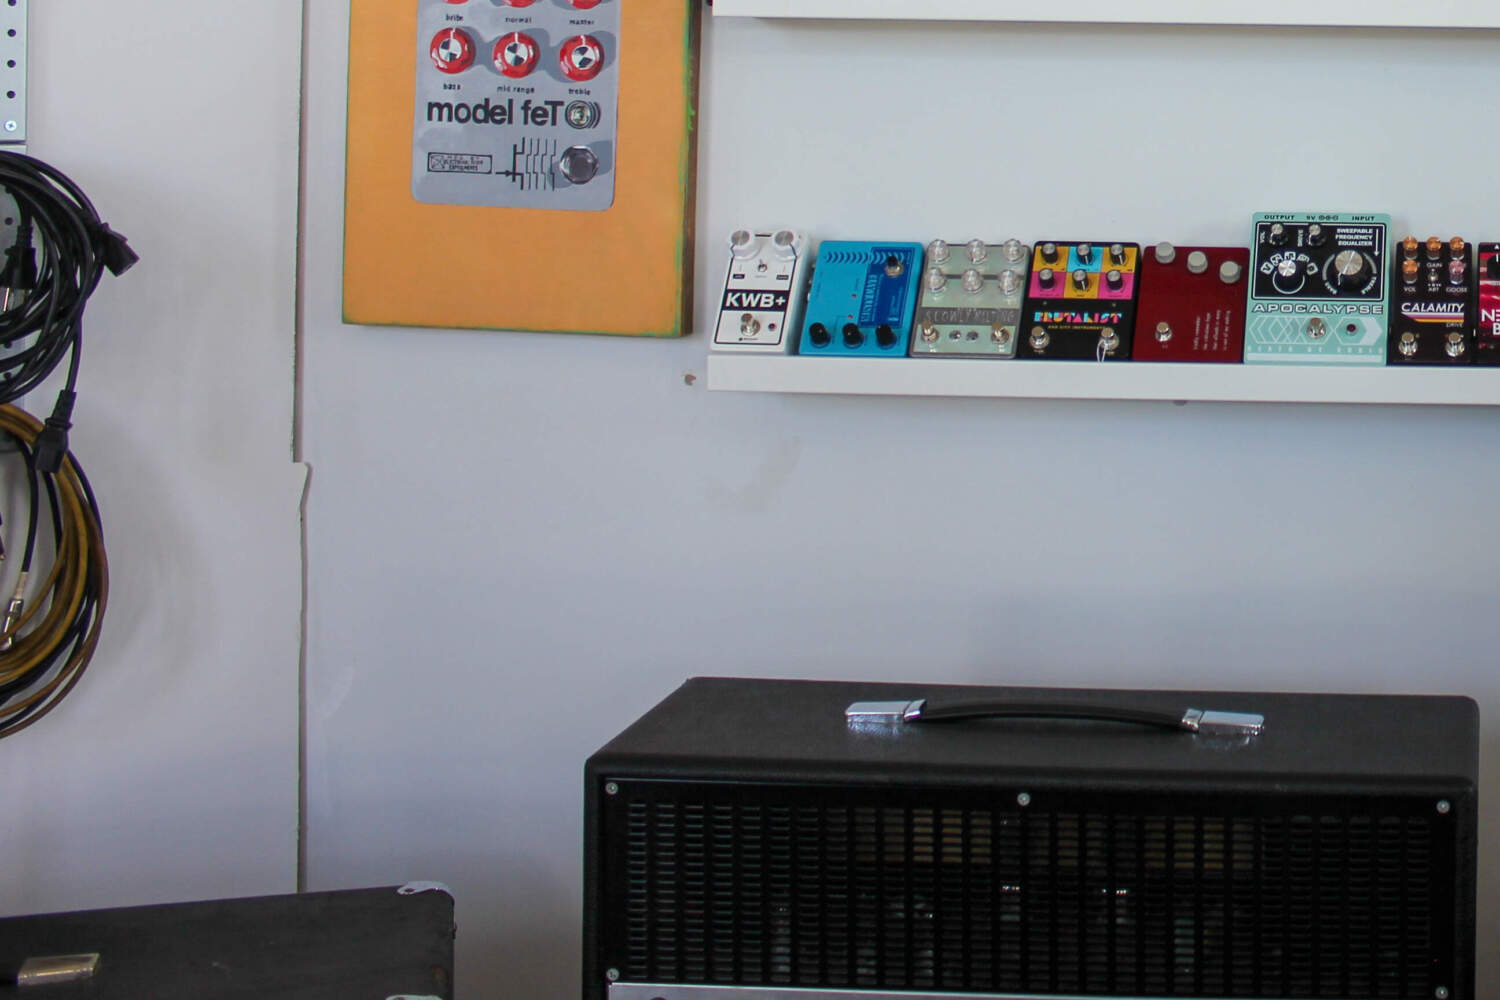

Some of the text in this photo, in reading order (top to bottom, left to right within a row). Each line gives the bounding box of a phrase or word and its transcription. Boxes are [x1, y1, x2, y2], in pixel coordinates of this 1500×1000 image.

[443, 83, 461, 91] bass
[427, 97, 565, 126] model feT
[726, 292, 786, 308] KWB+
[1252, 303, 1384, 315] APOCALYPSE
[1401, 302, 1465, 312] CALAMITY
[1033, 311, 1123, 324] BRUTALIST
